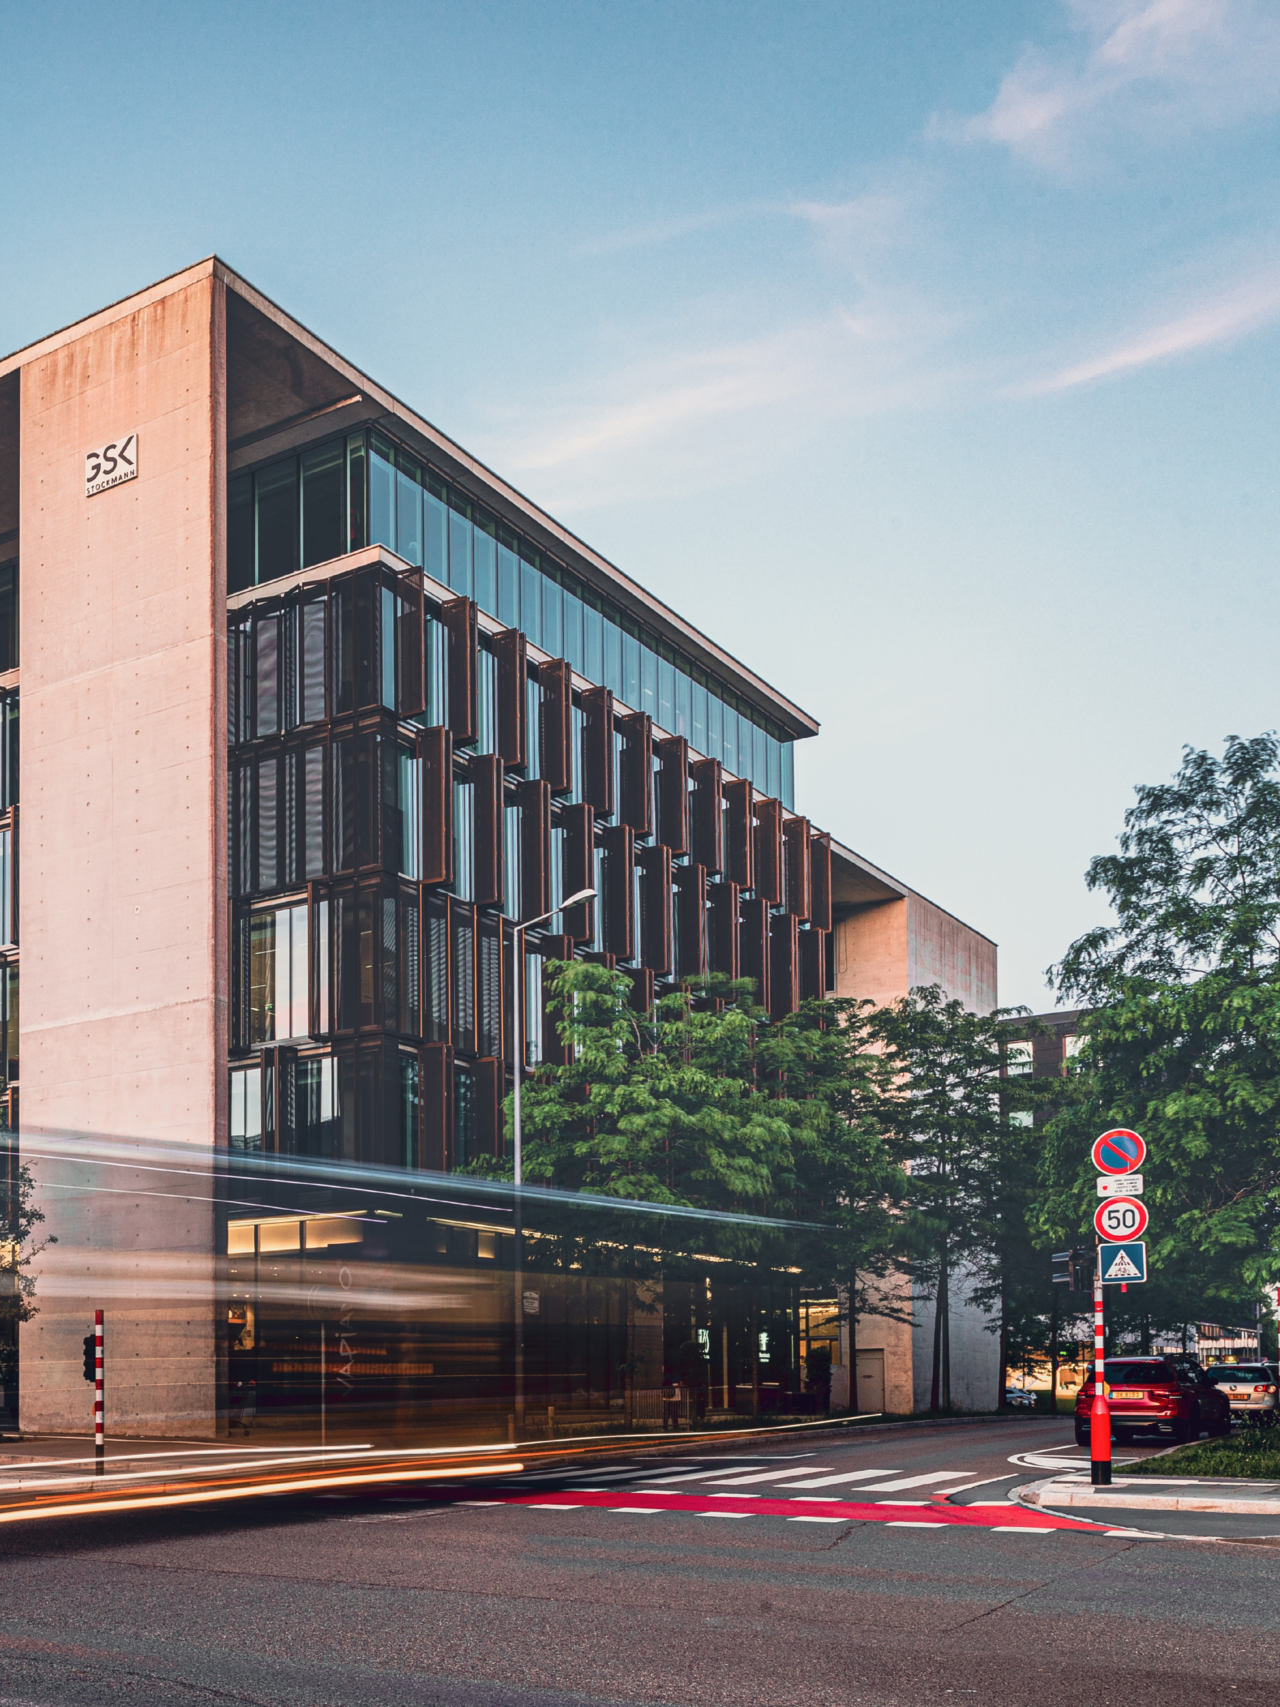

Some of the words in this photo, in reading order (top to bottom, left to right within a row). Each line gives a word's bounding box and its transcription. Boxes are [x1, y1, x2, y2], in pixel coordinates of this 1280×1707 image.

[86, 434, 135, 483] GSK
[86, 469, 135, 495] STOCKMANN
[1107, 1208, 1136, 1230] 50
